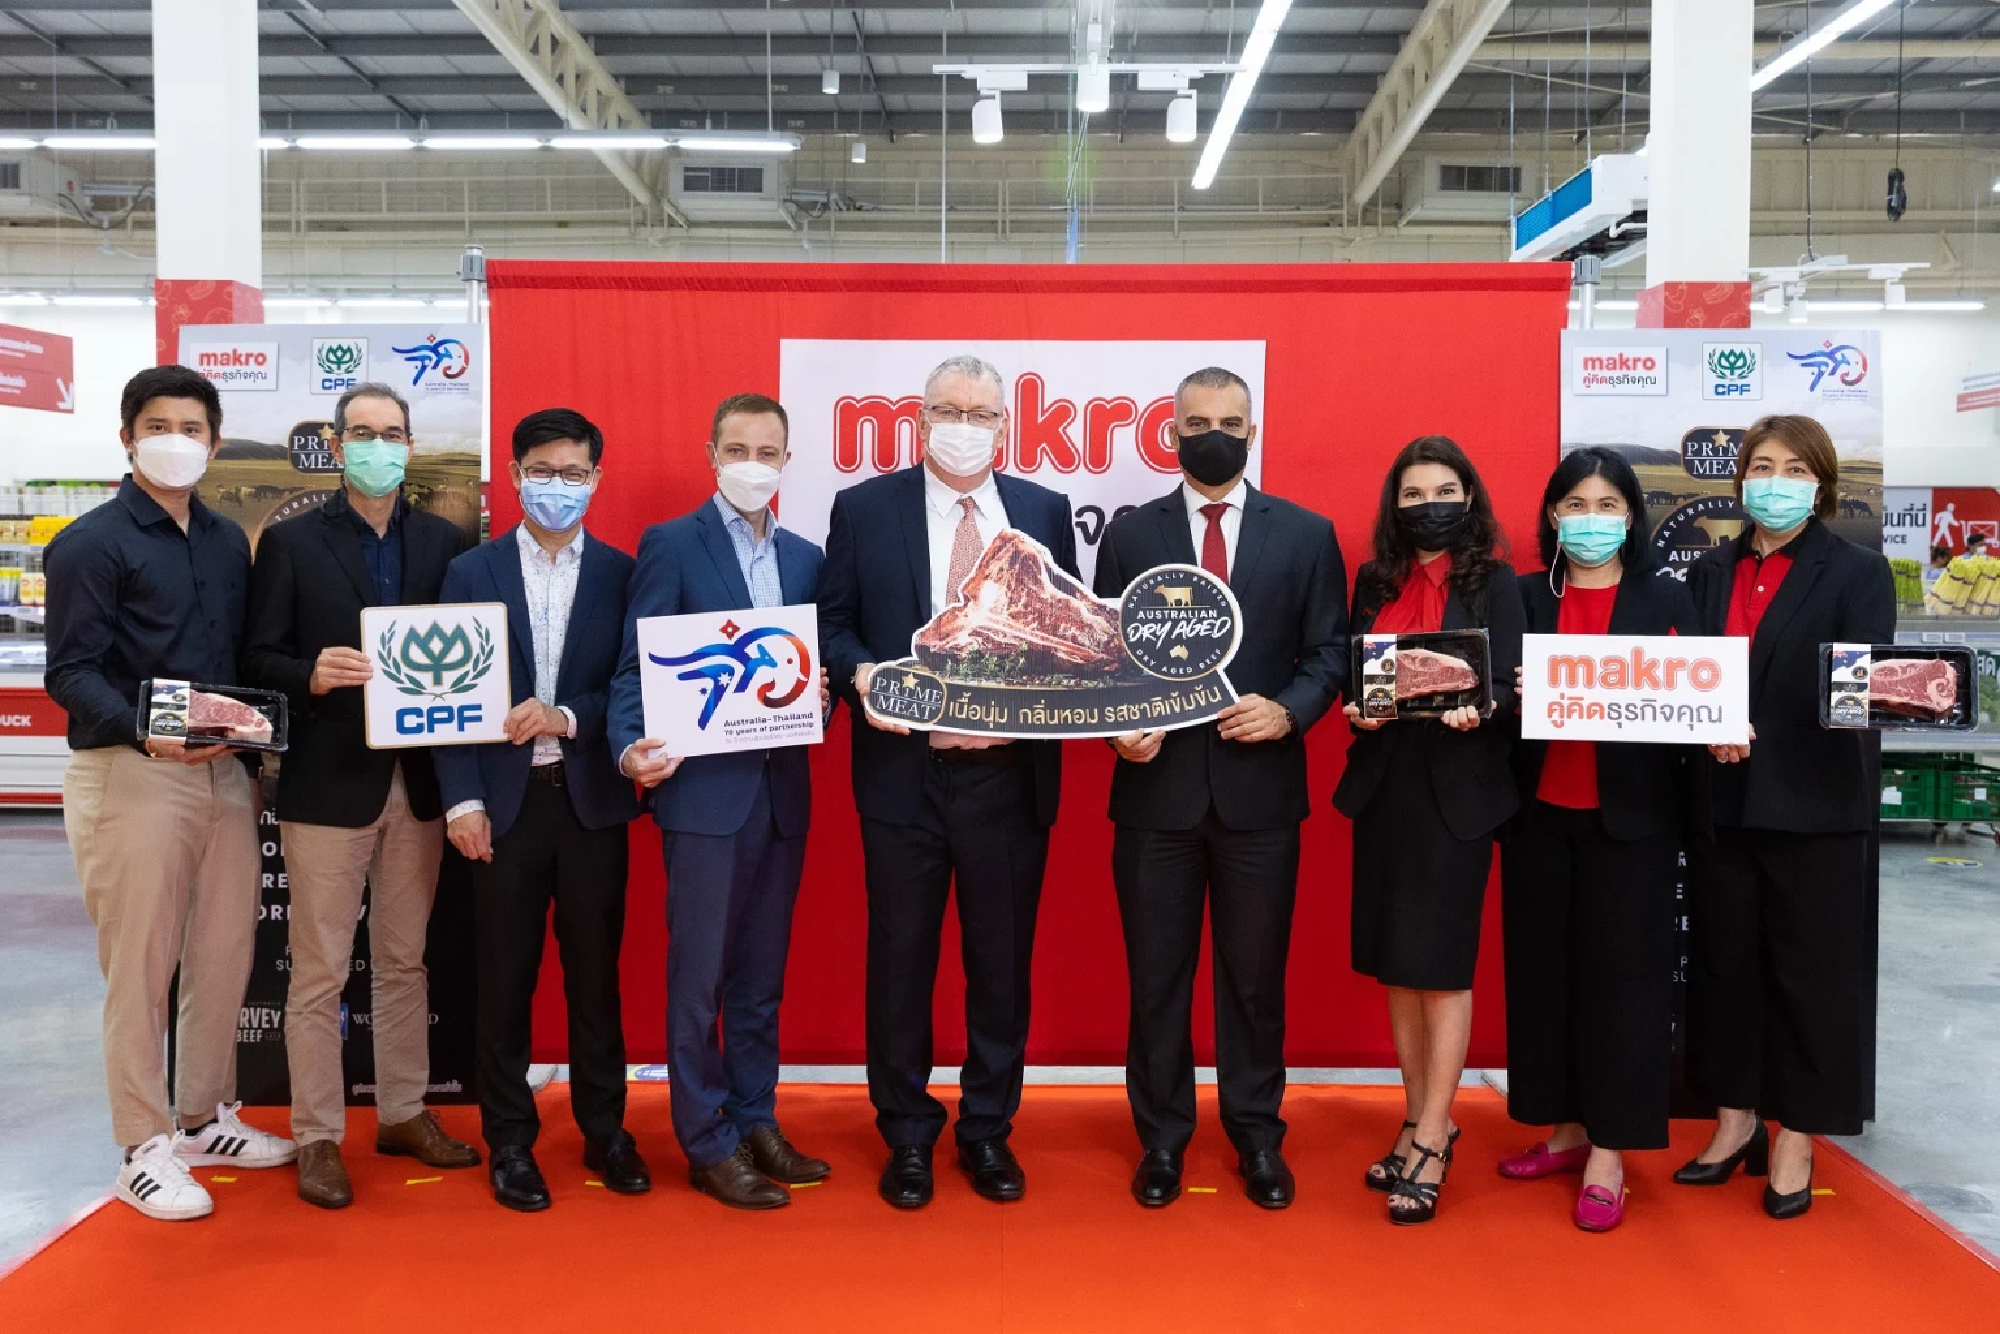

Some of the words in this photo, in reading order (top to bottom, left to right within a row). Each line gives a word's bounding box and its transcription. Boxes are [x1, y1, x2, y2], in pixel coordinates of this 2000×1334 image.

[198, 348, 267, 366] makro
[1583, 353, 1656, 371] makro
[322, 378, 356, 391] CPF
[1714, 383, 1751, 396] CPF
[833, 372, 1184, 475] mkro
[1686, 442, 1744, 457] PRIM
[297, 452, 344, 469] MEA
[1693, 460, 1737, 475] MEA
[1137, 609, 1217, 620] AUSTRALIAN
[1127, 620, 1171, 650] DRY
[1171, 616, 1231, 641] AGED
[1547, 645, 1722, 692] makro
[872, 676, 943, 704] PRIME
[876, 695, 938, 720] MEAT
[949, 692, 1008, 728] เนื้อนุ่ม
[1019, 699, 1098, 725] กลิ่นหอม
[1104, 684, 1222, 723] รสชาติเข้มข้น
[1547, 692, 1723, 731] คู่คิดธุรกิจคุณ
[0, 714, 31, 727] UCK
[396, 703, 482, 735] CPF
[735, 727, 757, 736] years
[240, 1007, 281, 1028] RVEY
